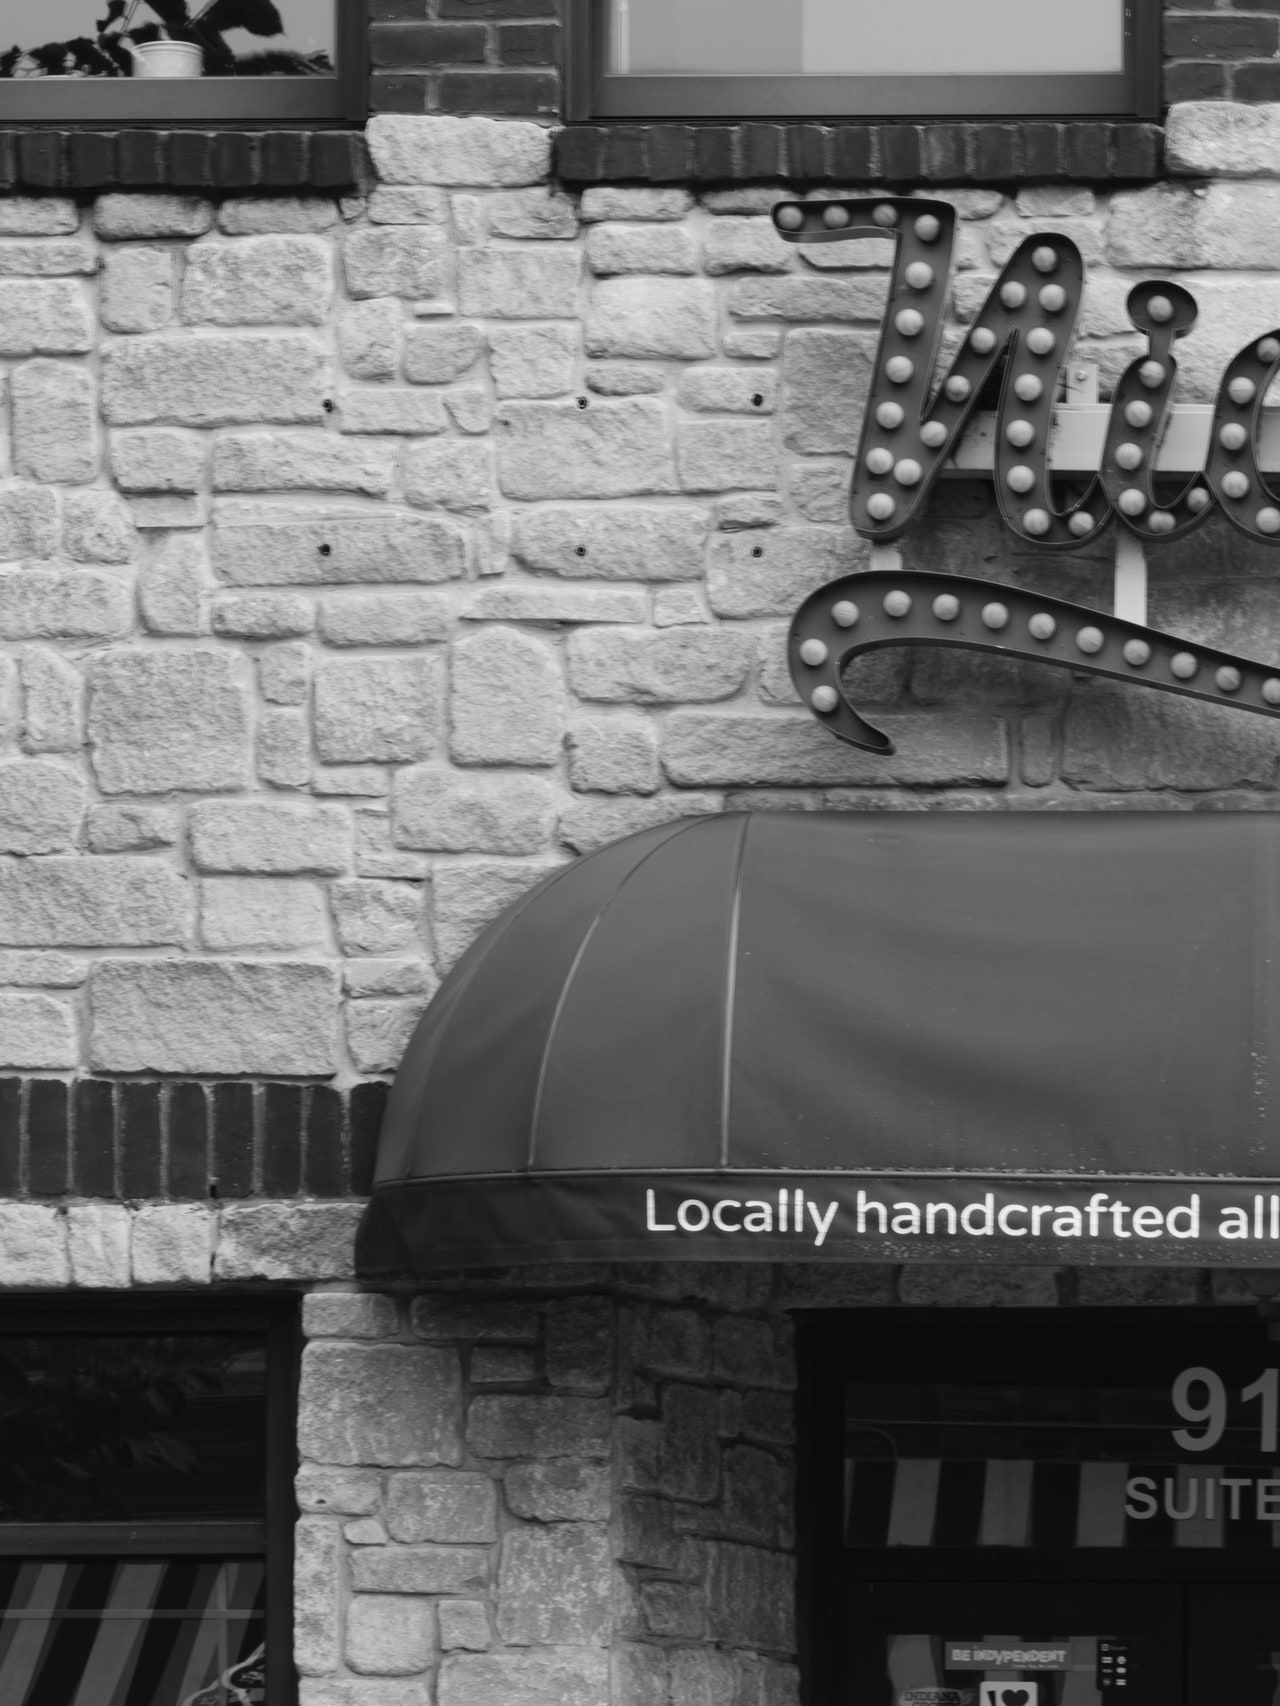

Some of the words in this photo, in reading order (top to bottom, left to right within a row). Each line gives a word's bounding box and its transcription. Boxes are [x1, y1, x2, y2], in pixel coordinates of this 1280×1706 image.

[646, 1188, 839, 1246] Locally
[857, 1190, 1200, 1239] handcrafted
[951, 1649, 971, 1662] BE
[904, 1691, 961, 1702] INDIANA
